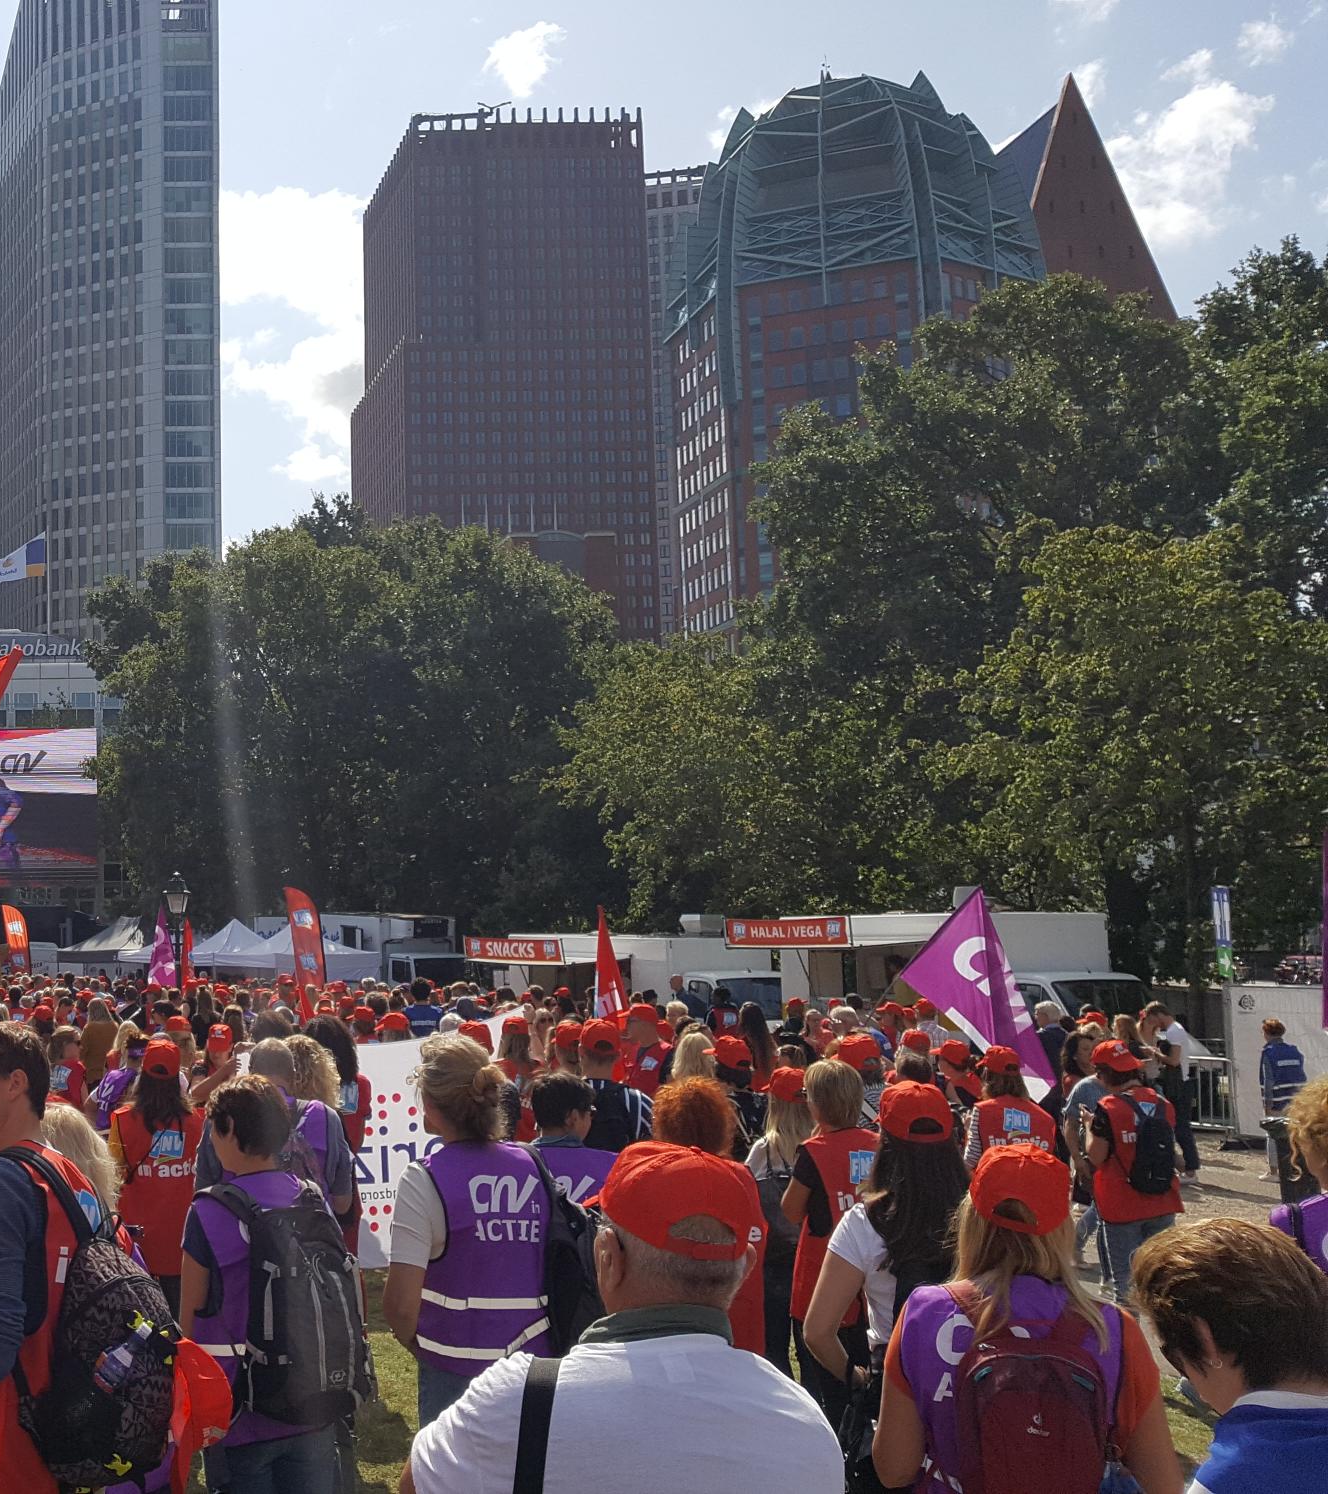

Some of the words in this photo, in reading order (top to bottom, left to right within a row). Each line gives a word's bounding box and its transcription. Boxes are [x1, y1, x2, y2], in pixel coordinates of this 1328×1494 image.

[750, 926, 786, 938] HALAL
[791, 925, 823, 938] VEGA
[485, 941, 535, 959] SNACKS
[1005, 1112, 1030, 1128] FNV
[851, 1155, 875, 1180] FN
[475, 1219, 540, 1243] ACTIE
